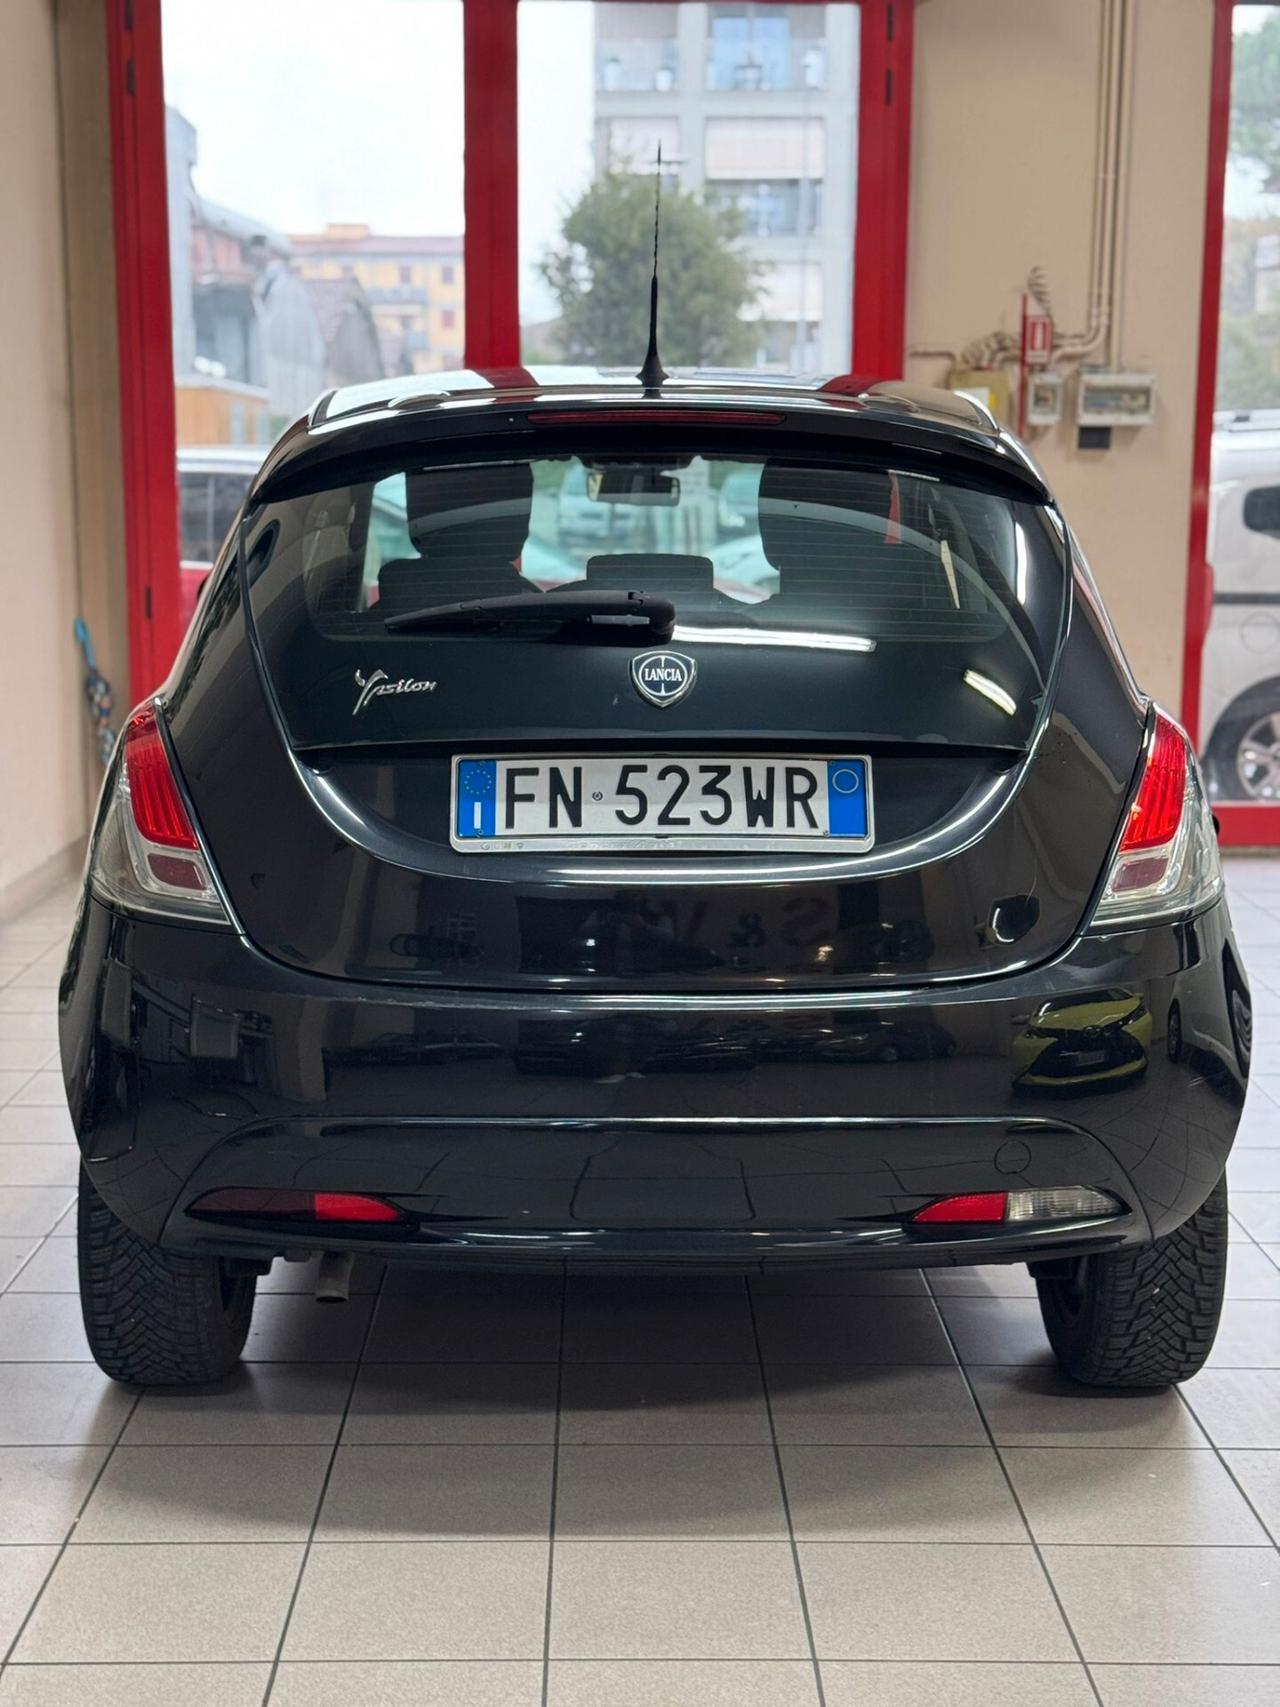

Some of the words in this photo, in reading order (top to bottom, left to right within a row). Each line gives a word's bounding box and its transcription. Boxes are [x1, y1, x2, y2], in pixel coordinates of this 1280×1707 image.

[352, 669, 437, 715] Ypsilon
[644, 667, 683, 682] LANCIA
[504, 766, 582, 829] FN
[615, 764, 819, 829] 523WR
